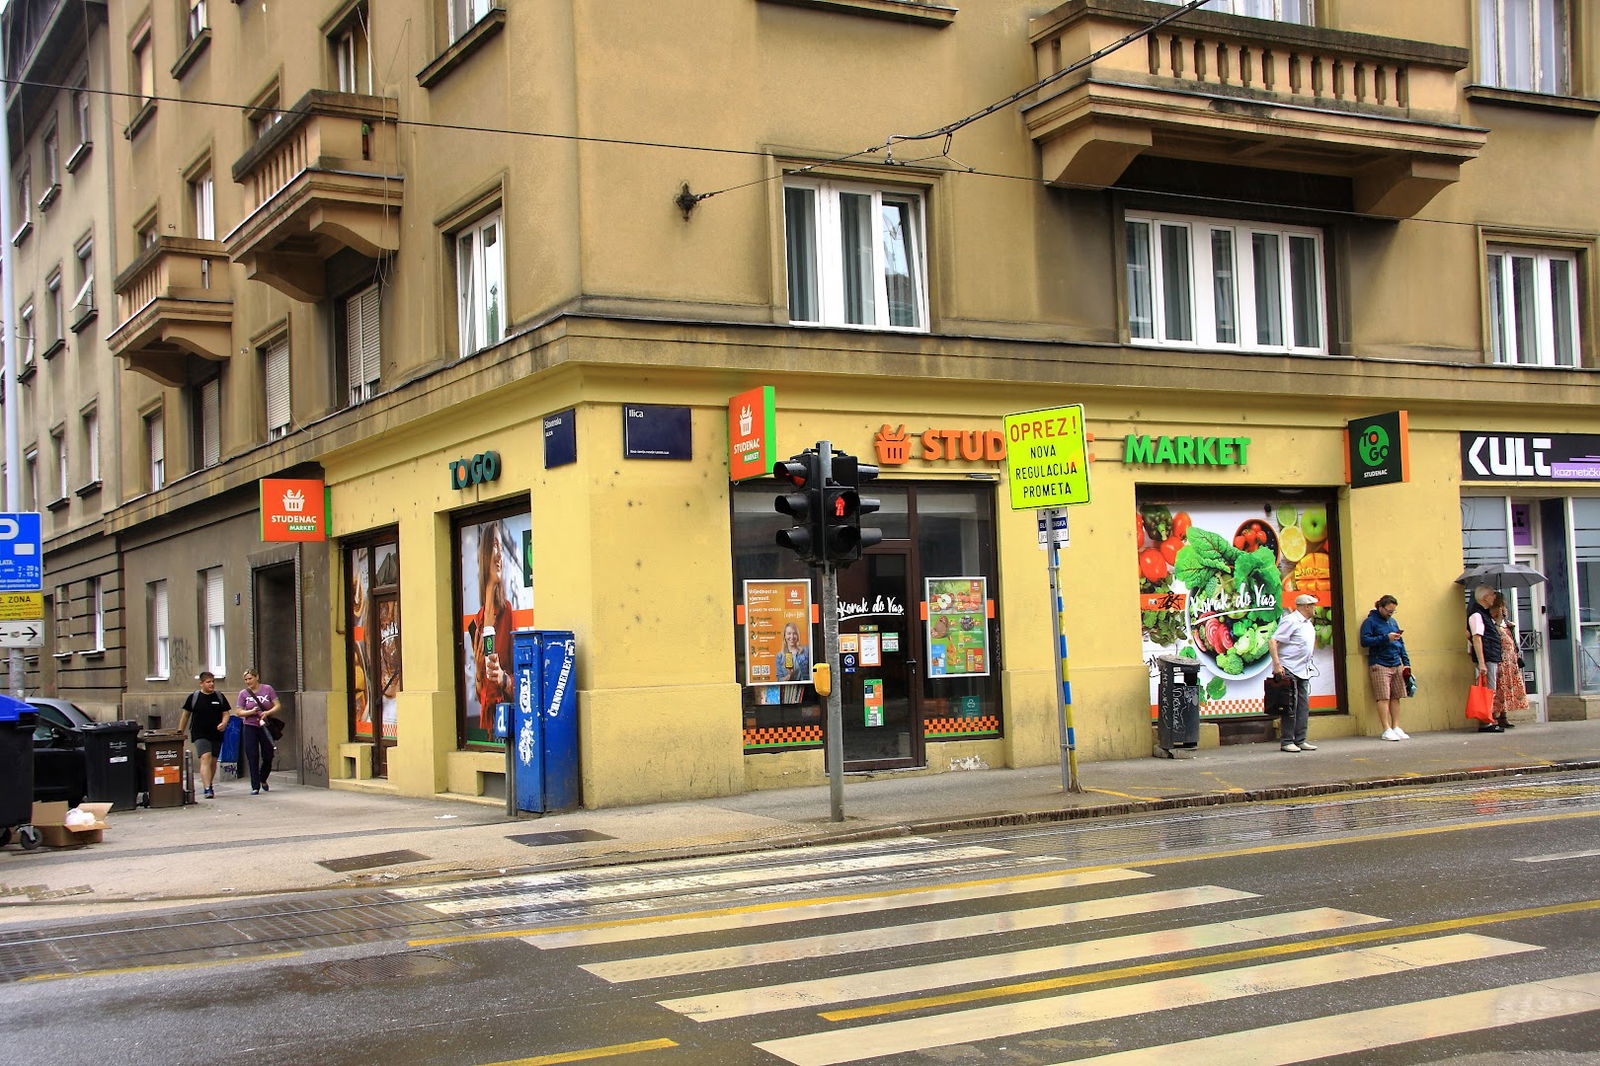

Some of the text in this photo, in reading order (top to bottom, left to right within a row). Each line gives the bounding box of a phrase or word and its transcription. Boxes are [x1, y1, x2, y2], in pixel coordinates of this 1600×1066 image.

[629, 409, 644, 418] Ilica
[1010, 415, 1078, 443] OPREZ!
[733, 438, 761, 454] STUDENAC
[1361, 431, 1379, 447] TO
[743, 452, 760, 462] MARKET
[1030, 444, 1057, 459] NOVA
[1122, 434, 1252, 466] MARKET
[1369, 445, 1389, 461] GO
[1468, 436, 1552, 477] KULT
[449, 450, 502, 491] TO GO
[1015, 460, 1078, 481] REGULACIJA
[1363, 468, 1388, 478] STUDENAC
[1023, 482, 1072, 499] PROMETA
[271, 515, 317, 523] STUDENAC
[8, 596, 31, 604] ZONA
[836, 594, 904, 617] Korak do Vas
[1190, 588, 1230, 617] Korak
[1235, 583, 1252, 609] do
[1253, 583, 1277, 607] Vas
